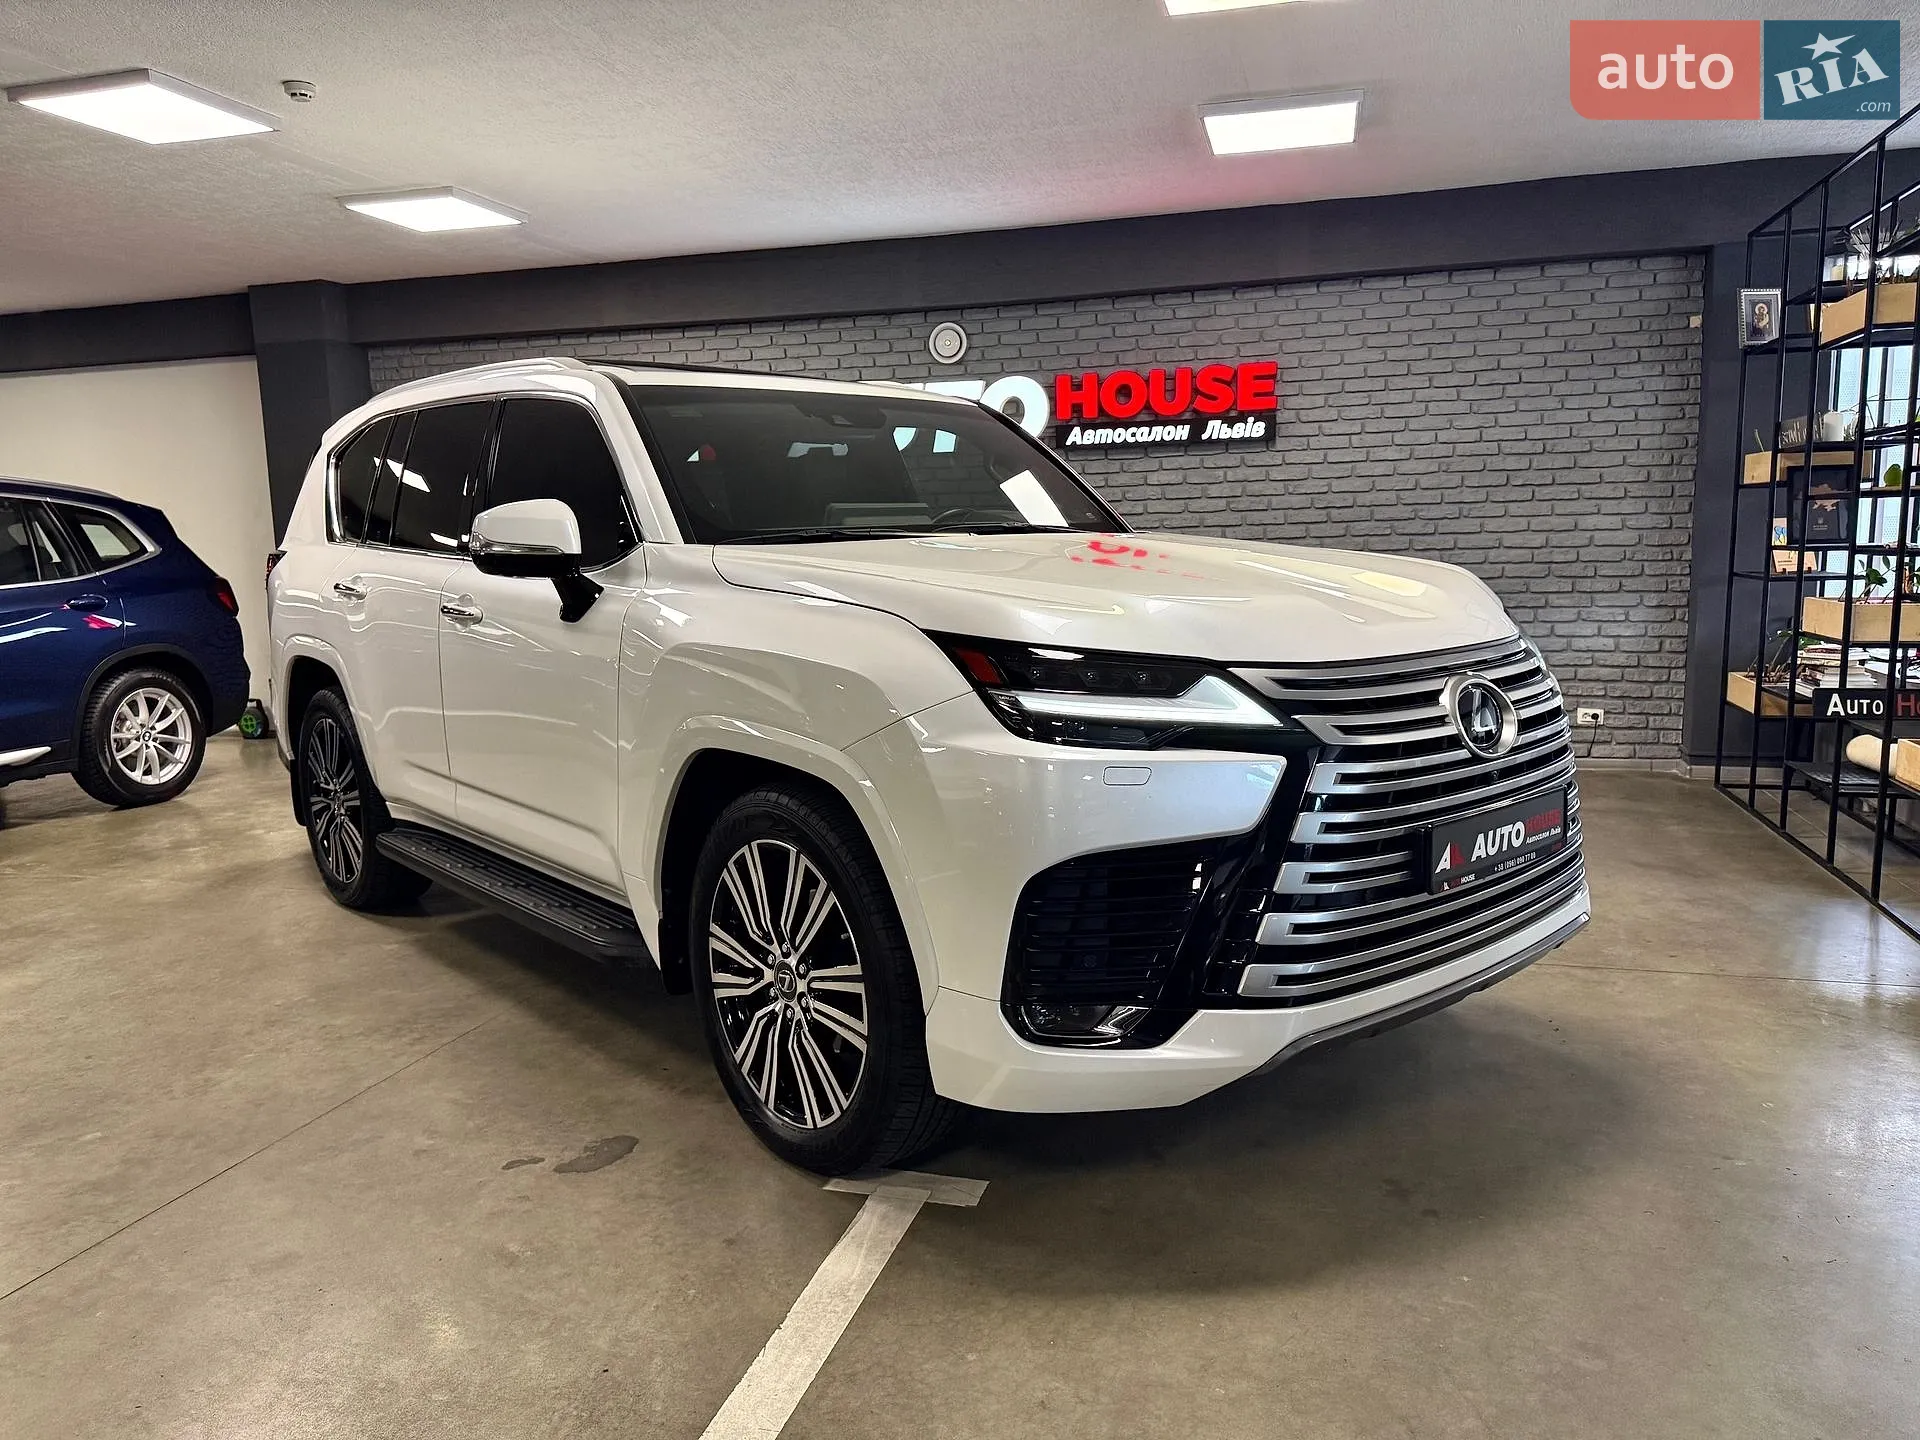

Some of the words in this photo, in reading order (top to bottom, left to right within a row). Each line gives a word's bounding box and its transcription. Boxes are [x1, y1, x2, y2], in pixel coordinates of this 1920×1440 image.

[1054, 360, 1279, 421] HOUSE
[1065, 422, 1191, 447] Автосалон
[1201, 416, 1266, 441] Львів
[1471, 821, 1525, 863] AUTO
